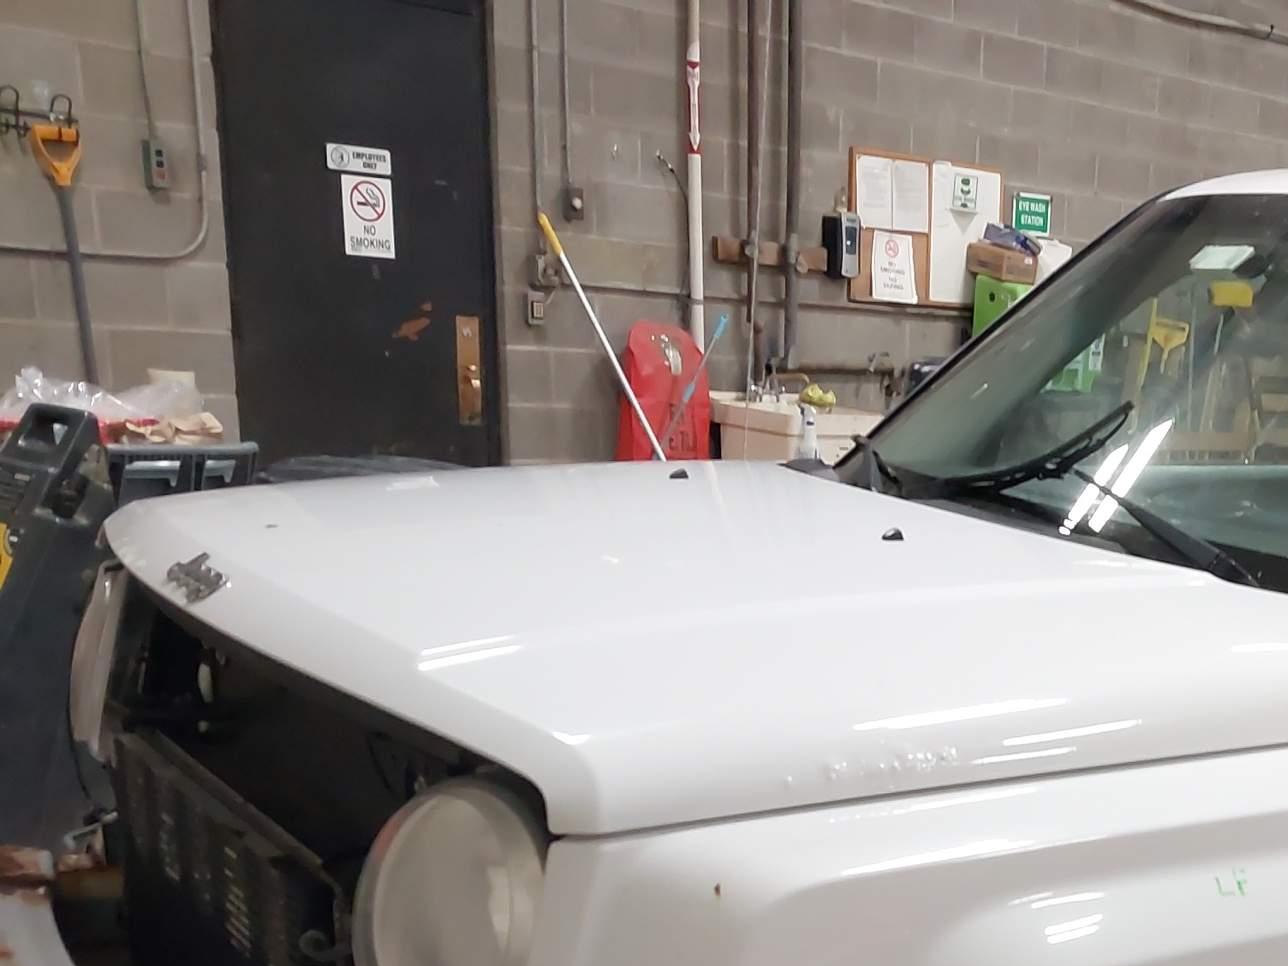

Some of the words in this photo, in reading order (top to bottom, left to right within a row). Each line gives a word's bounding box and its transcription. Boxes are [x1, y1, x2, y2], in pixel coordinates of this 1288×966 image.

[352, 151, 387, 163] EMPLOYEES
[362, 161, 377, 170] ONLY
[1018, 200, 1030, 212] EYE
[1030, 202, 1046, 213] WASH
[1020, 214, 1044, 227] STATION
[363, 224, 377, 236] NO
[350, 235, 391, 250] SMOKING
